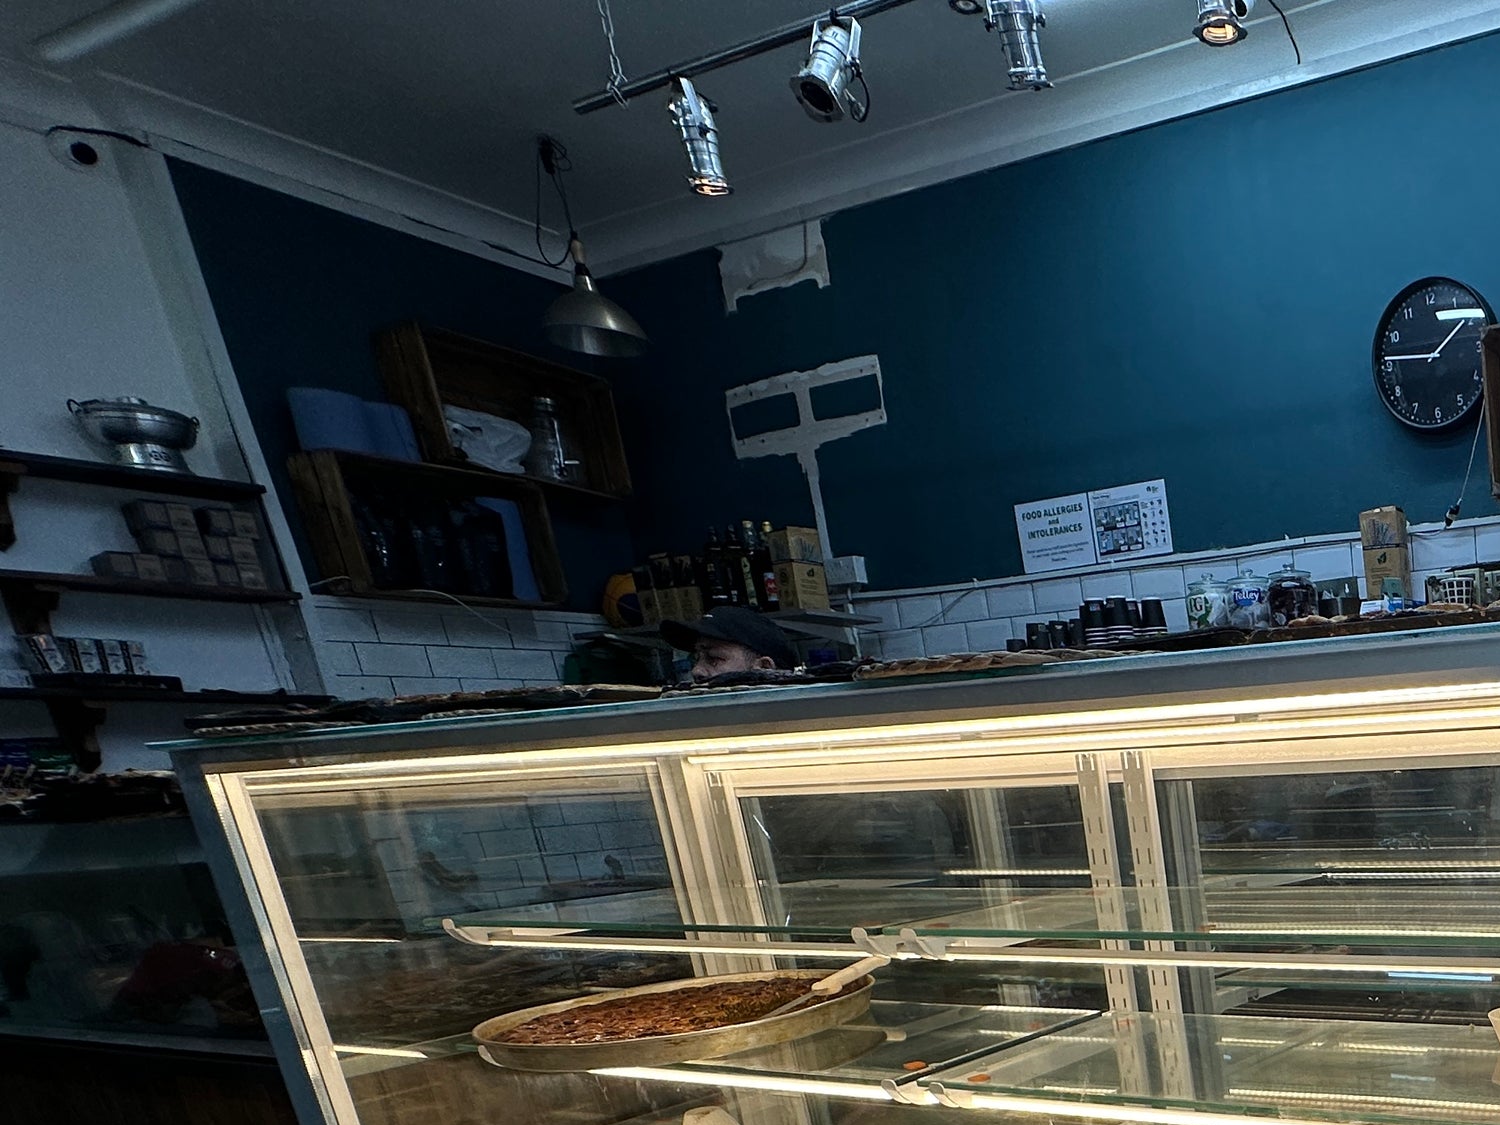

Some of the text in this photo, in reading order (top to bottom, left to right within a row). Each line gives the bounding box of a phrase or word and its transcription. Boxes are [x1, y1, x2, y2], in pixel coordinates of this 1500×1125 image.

[1425, 294, 1436, 306] 12
[1403, 307, 1413, 320] 11
[1389, 331, 1400, 343] 10
[1386, 361, 1393, 372] 9
[1394, 386, 1401, 397] 8
[1456, 394, 1464, 406] 5
[1412, 403, 1419, 414] 7
[1434, 407, 1441, 419] 6
[1022, 502, 1083, 521] FOOD ALLERGIES
[1048, 517, 1060, 525] and
[1027, 523, 1083, 539] INTOLERANCES
[1234, 590, 1260, 601] Tetley
